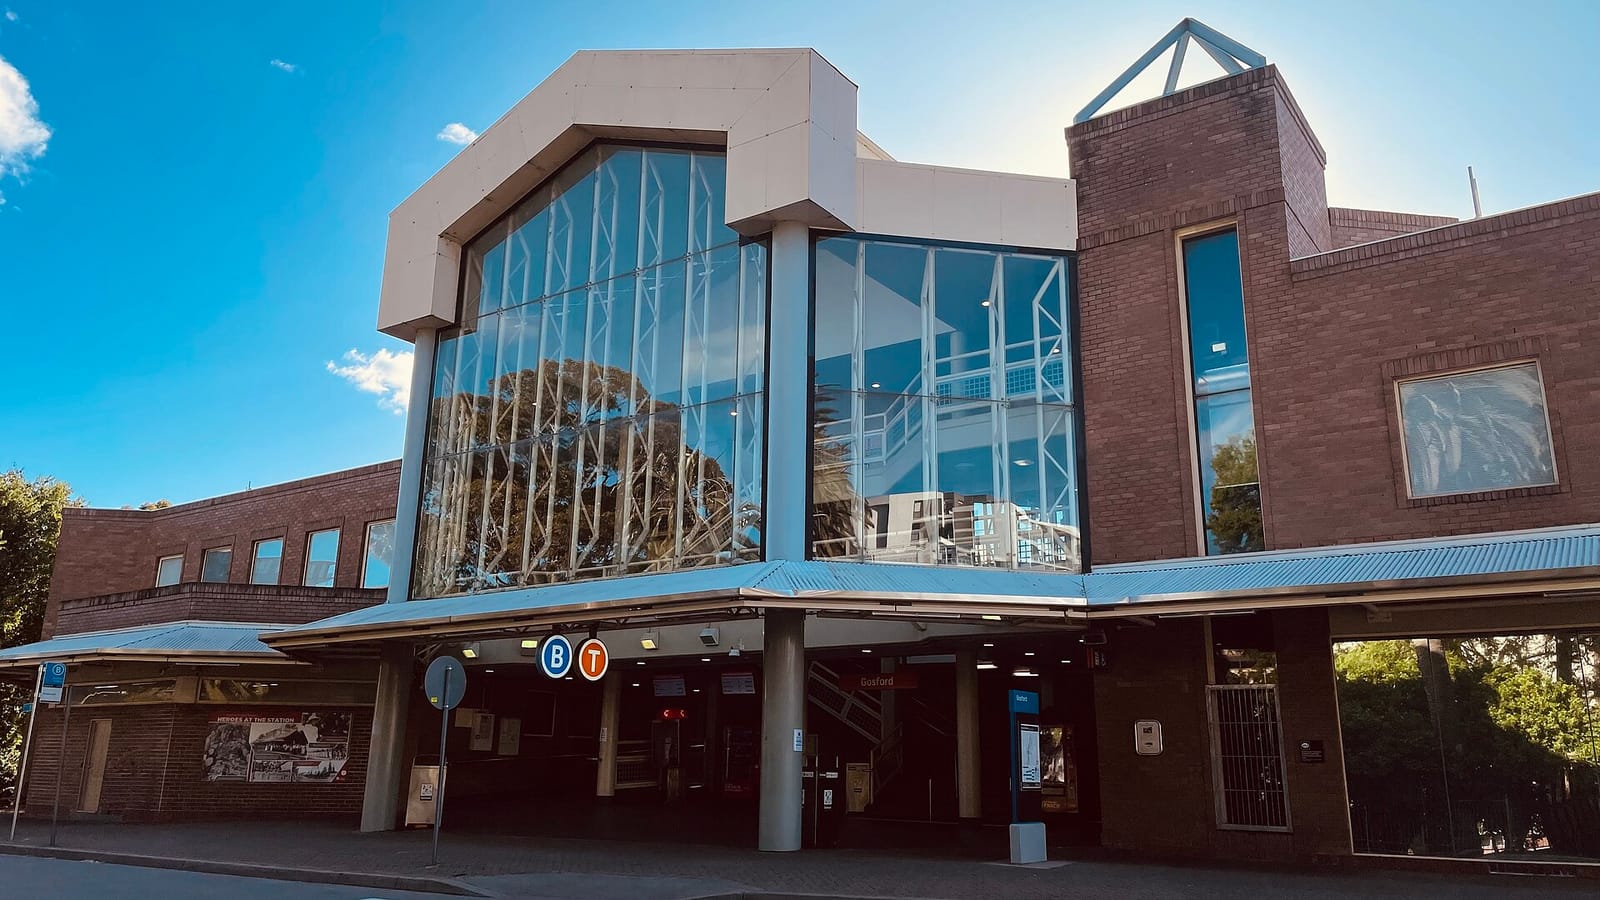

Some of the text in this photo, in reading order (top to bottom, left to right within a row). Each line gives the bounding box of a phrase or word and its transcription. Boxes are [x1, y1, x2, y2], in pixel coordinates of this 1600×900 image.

[550, 644, 564, 668] B
[587, 649, 601, 673] T
[860, 676, 894, 687] Gosford
